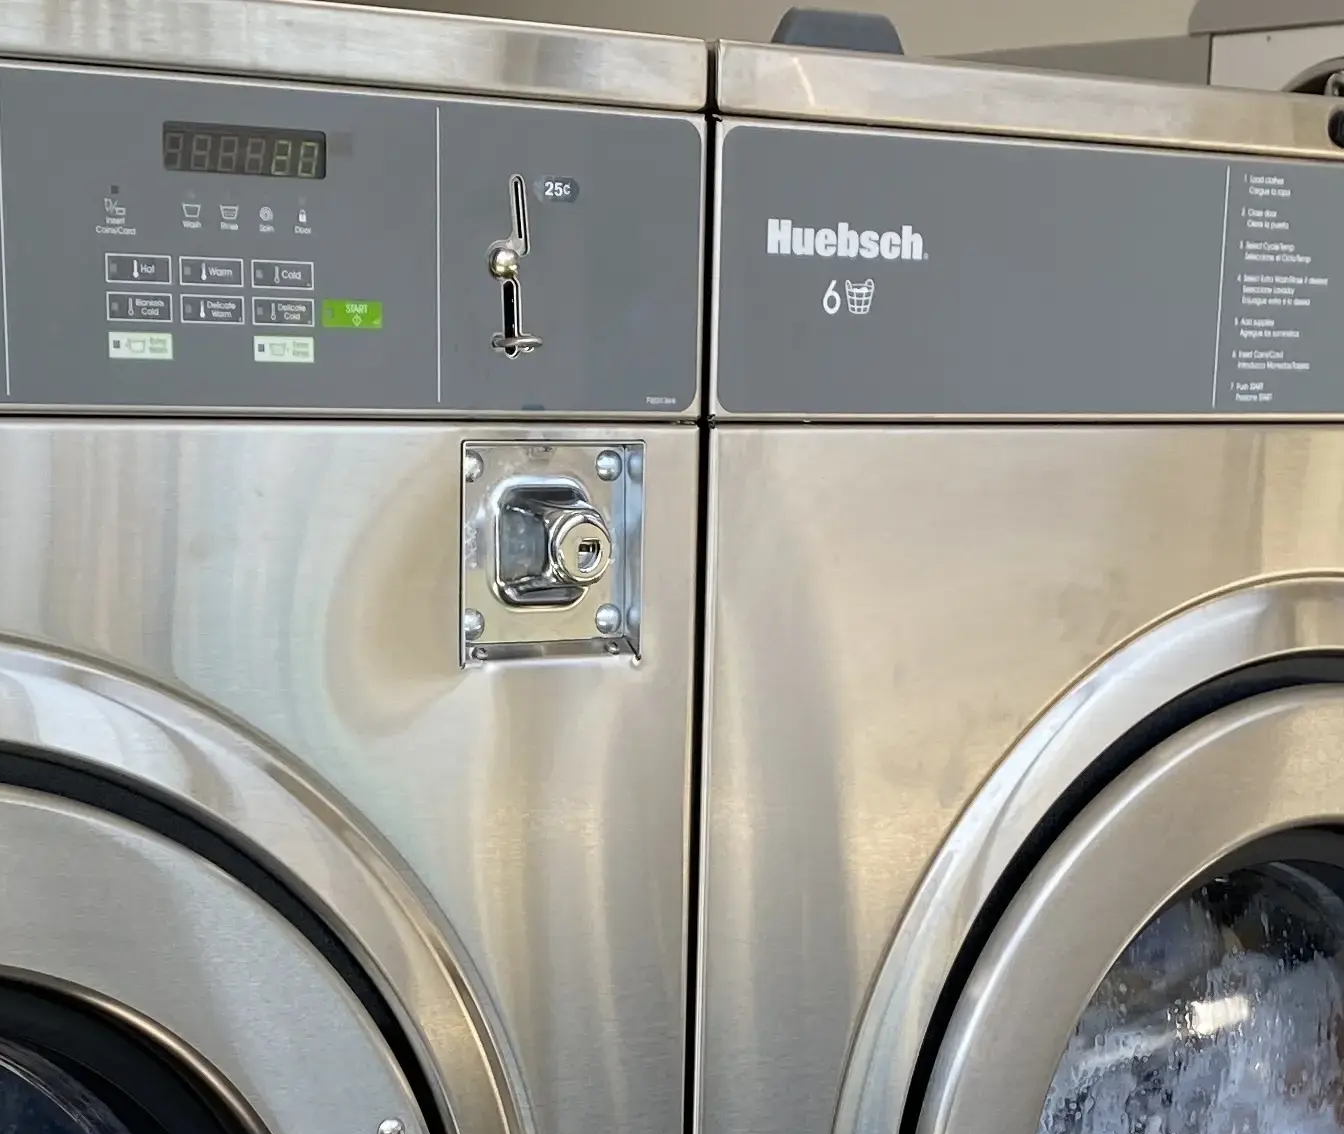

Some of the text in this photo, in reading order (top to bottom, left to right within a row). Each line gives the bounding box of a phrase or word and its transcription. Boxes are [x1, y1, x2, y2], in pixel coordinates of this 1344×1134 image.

[766, 218, 924, 260] Huebsch
[140, 263, 155, 274] Hot
[208, 267, 233, 277] Warm
[281, 270, 302, 280] Cold
[822, 279, 842, 315] 6
[141, 307, 159, 316] Cold
[345, 304, 368, 314] START
